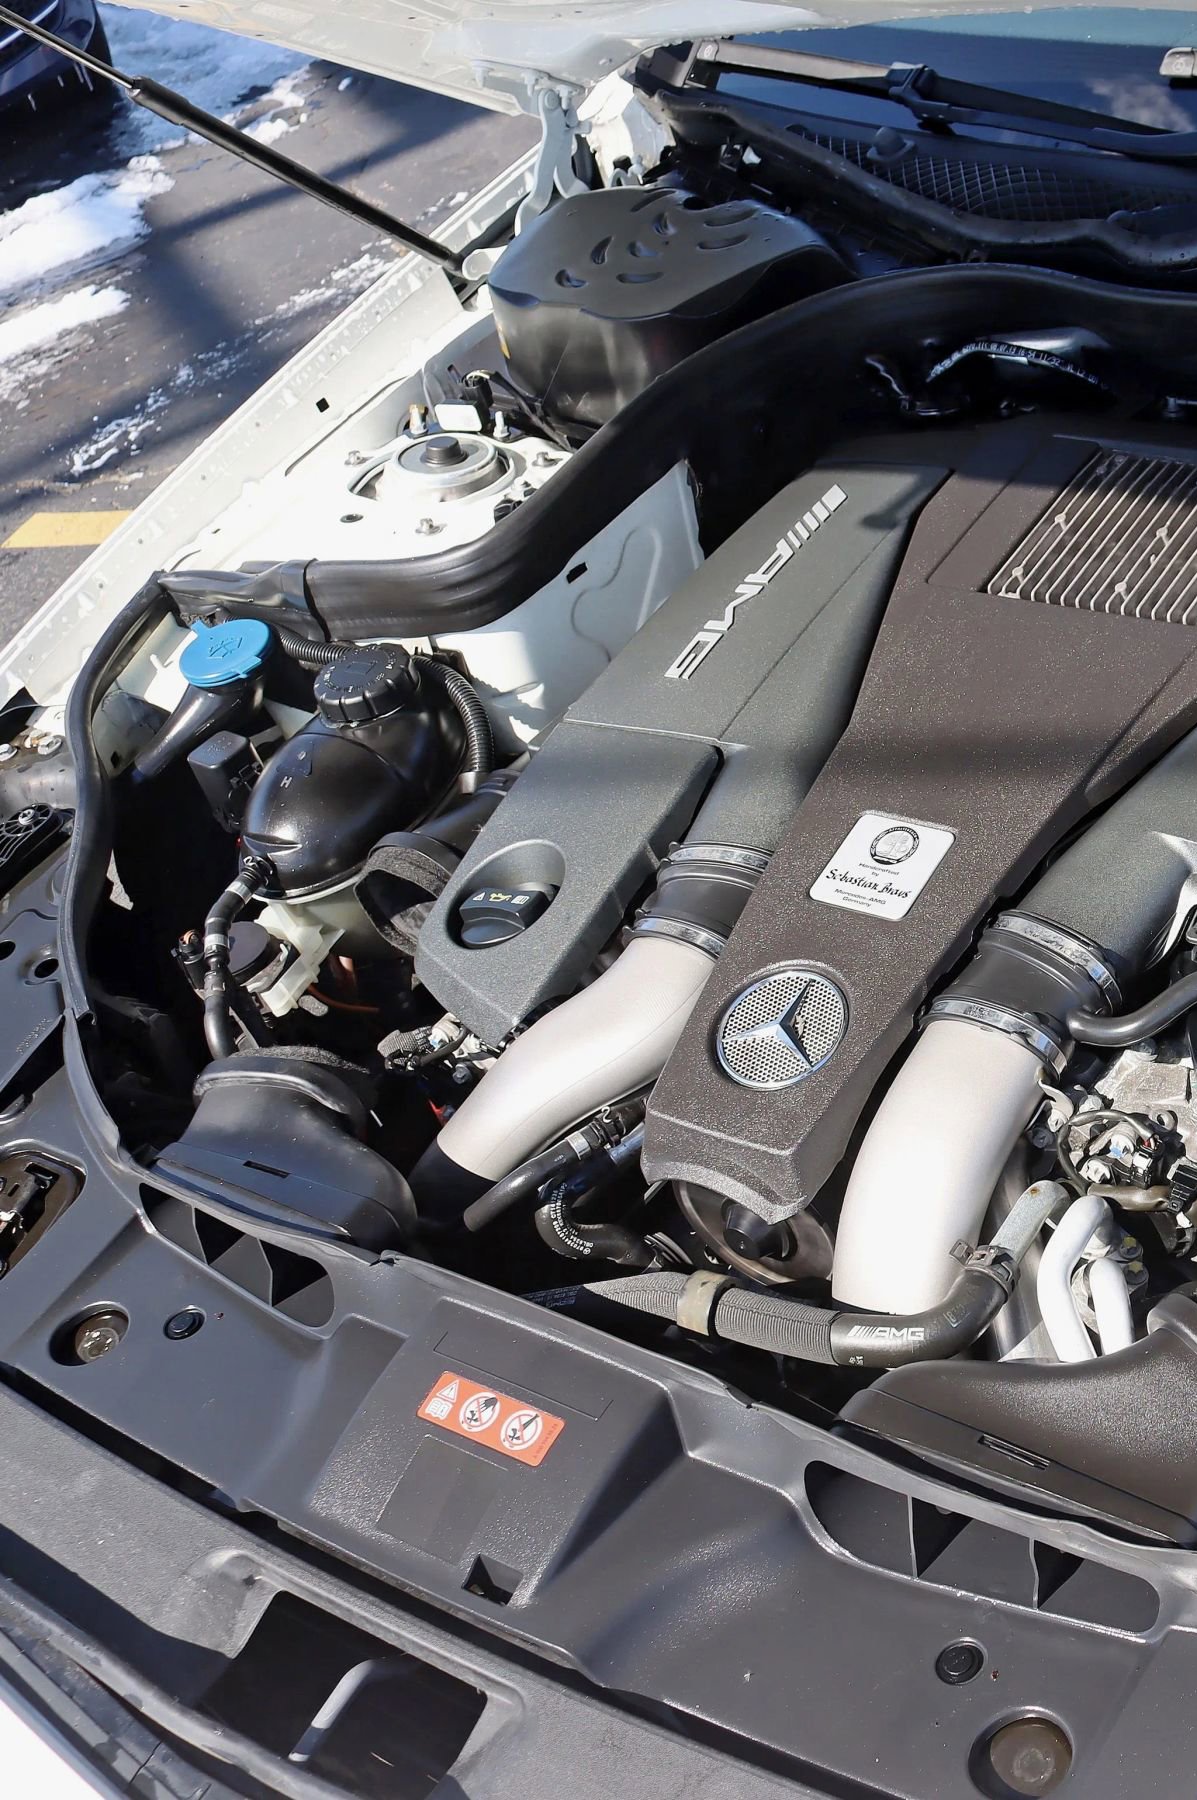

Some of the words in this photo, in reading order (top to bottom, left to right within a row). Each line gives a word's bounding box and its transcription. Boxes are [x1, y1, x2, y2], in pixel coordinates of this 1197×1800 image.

[664, 538, 795, 680] AMG
[825, 868, 878, 891] Sebastian
[871, 1326, 925, 1341] AMG
